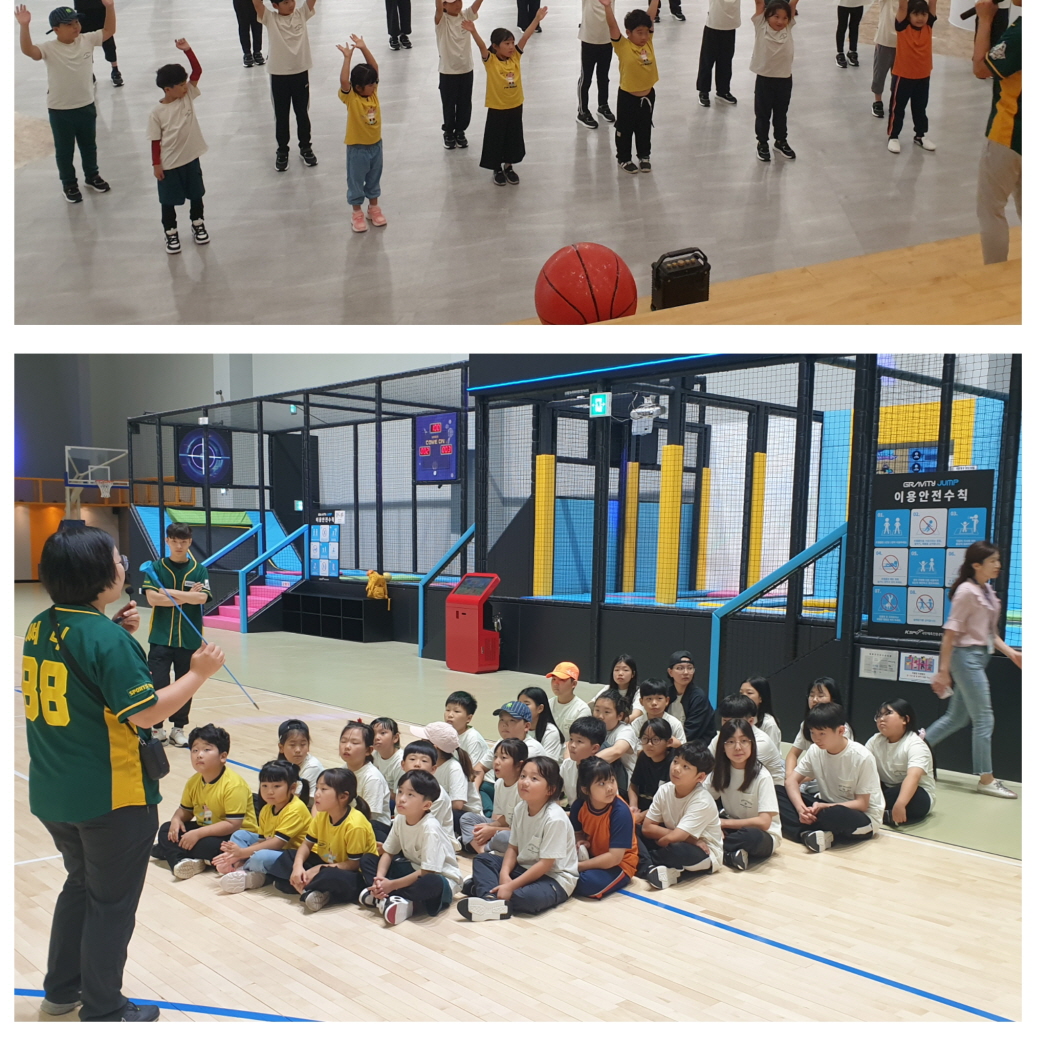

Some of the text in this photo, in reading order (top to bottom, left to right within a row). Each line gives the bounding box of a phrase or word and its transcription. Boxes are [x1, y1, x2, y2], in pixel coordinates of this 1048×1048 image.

[937, 479, 960, 487] JUMP
[894, 489, 968, 503] 이용안전수칙
[22, 656, 70, 727] 88
